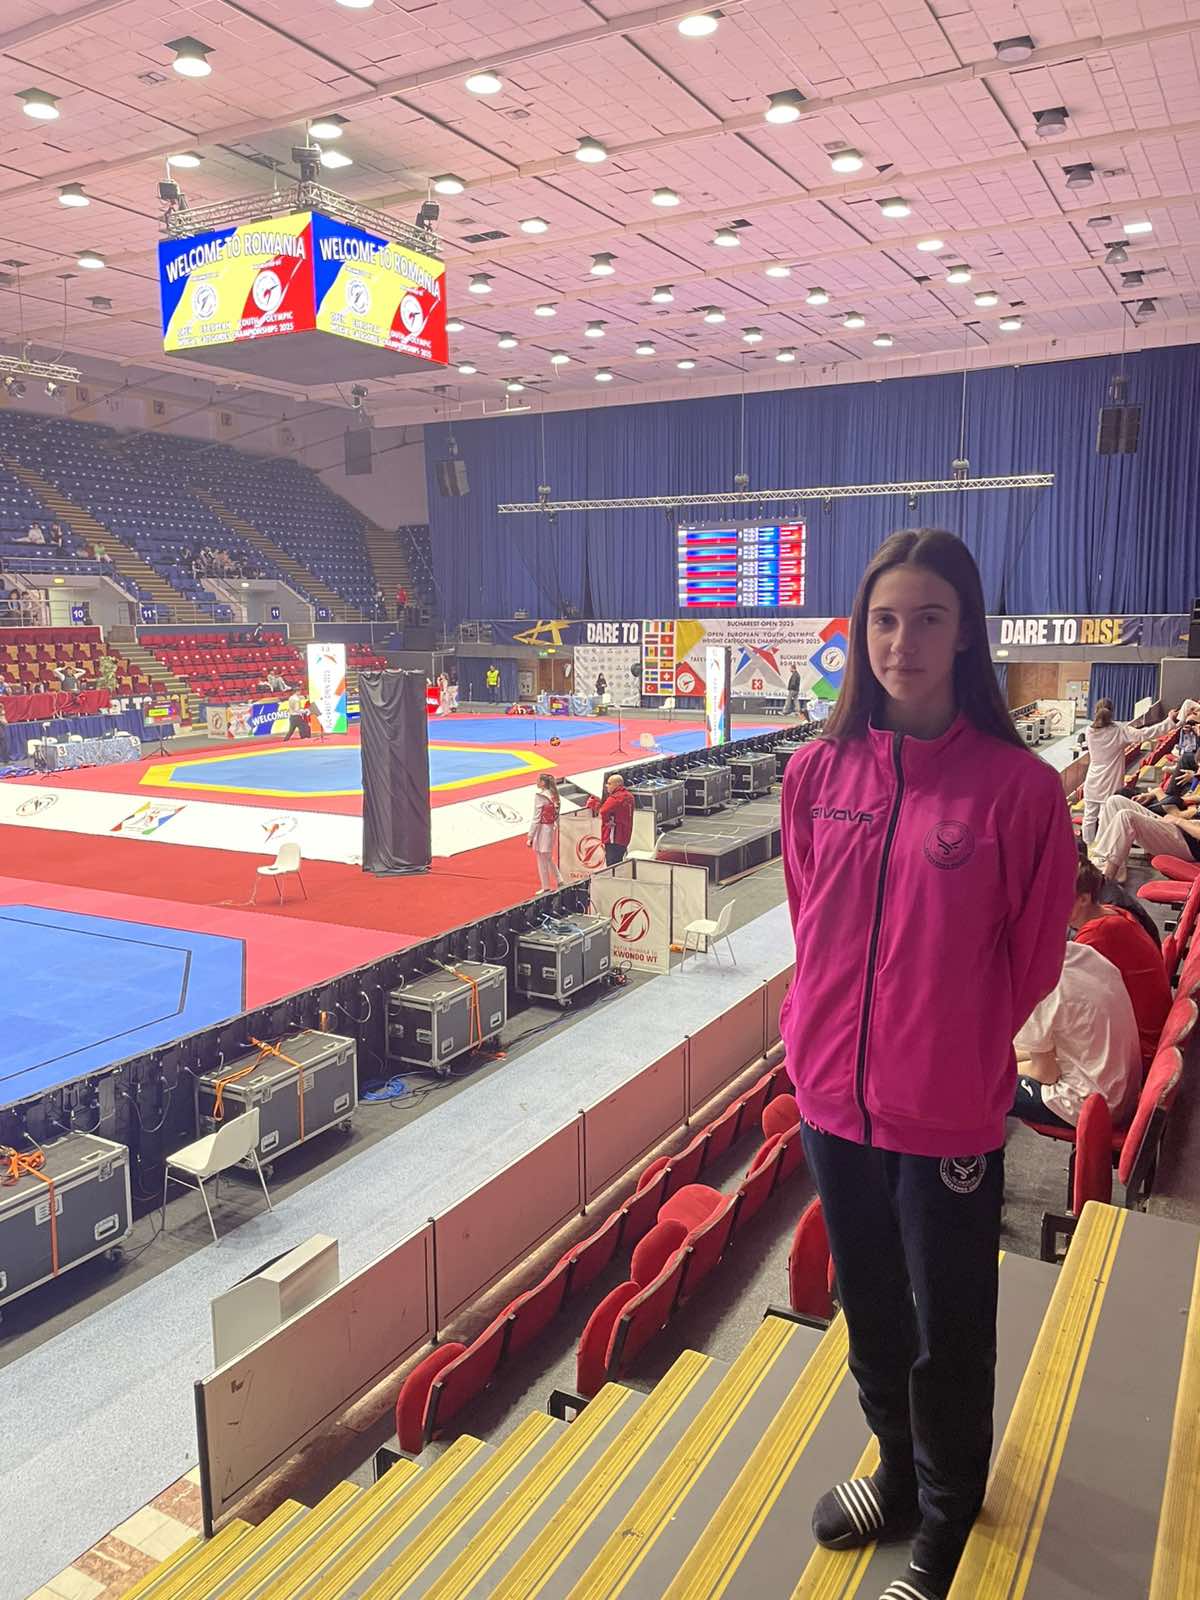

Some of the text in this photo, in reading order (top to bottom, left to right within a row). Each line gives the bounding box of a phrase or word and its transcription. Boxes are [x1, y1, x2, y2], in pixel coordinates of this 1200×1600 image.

[166, 239, 223, 284] WELCOME
[226, 236, 241, 259] TO
[244, 232, 306, 260] ROMANIA
[319, 237, 376, 264] WELCOME
[378, 246, 393, 270] TO
[394, 252, 440, 302] ROMANIA
[73, 609, 84, 618] 10
[143, 610, 152, 618] 11
[271, 609, 279, 617] 11
[587, 622, 639, 644] DARE TO
[1000, 618, 1124, 645] DARE TO RISE
[252, 711, 289, 726] WELCOME
[810, 807, 874, 825] GIVOVA
[613, 950, 657, 963] KWONDO WT
